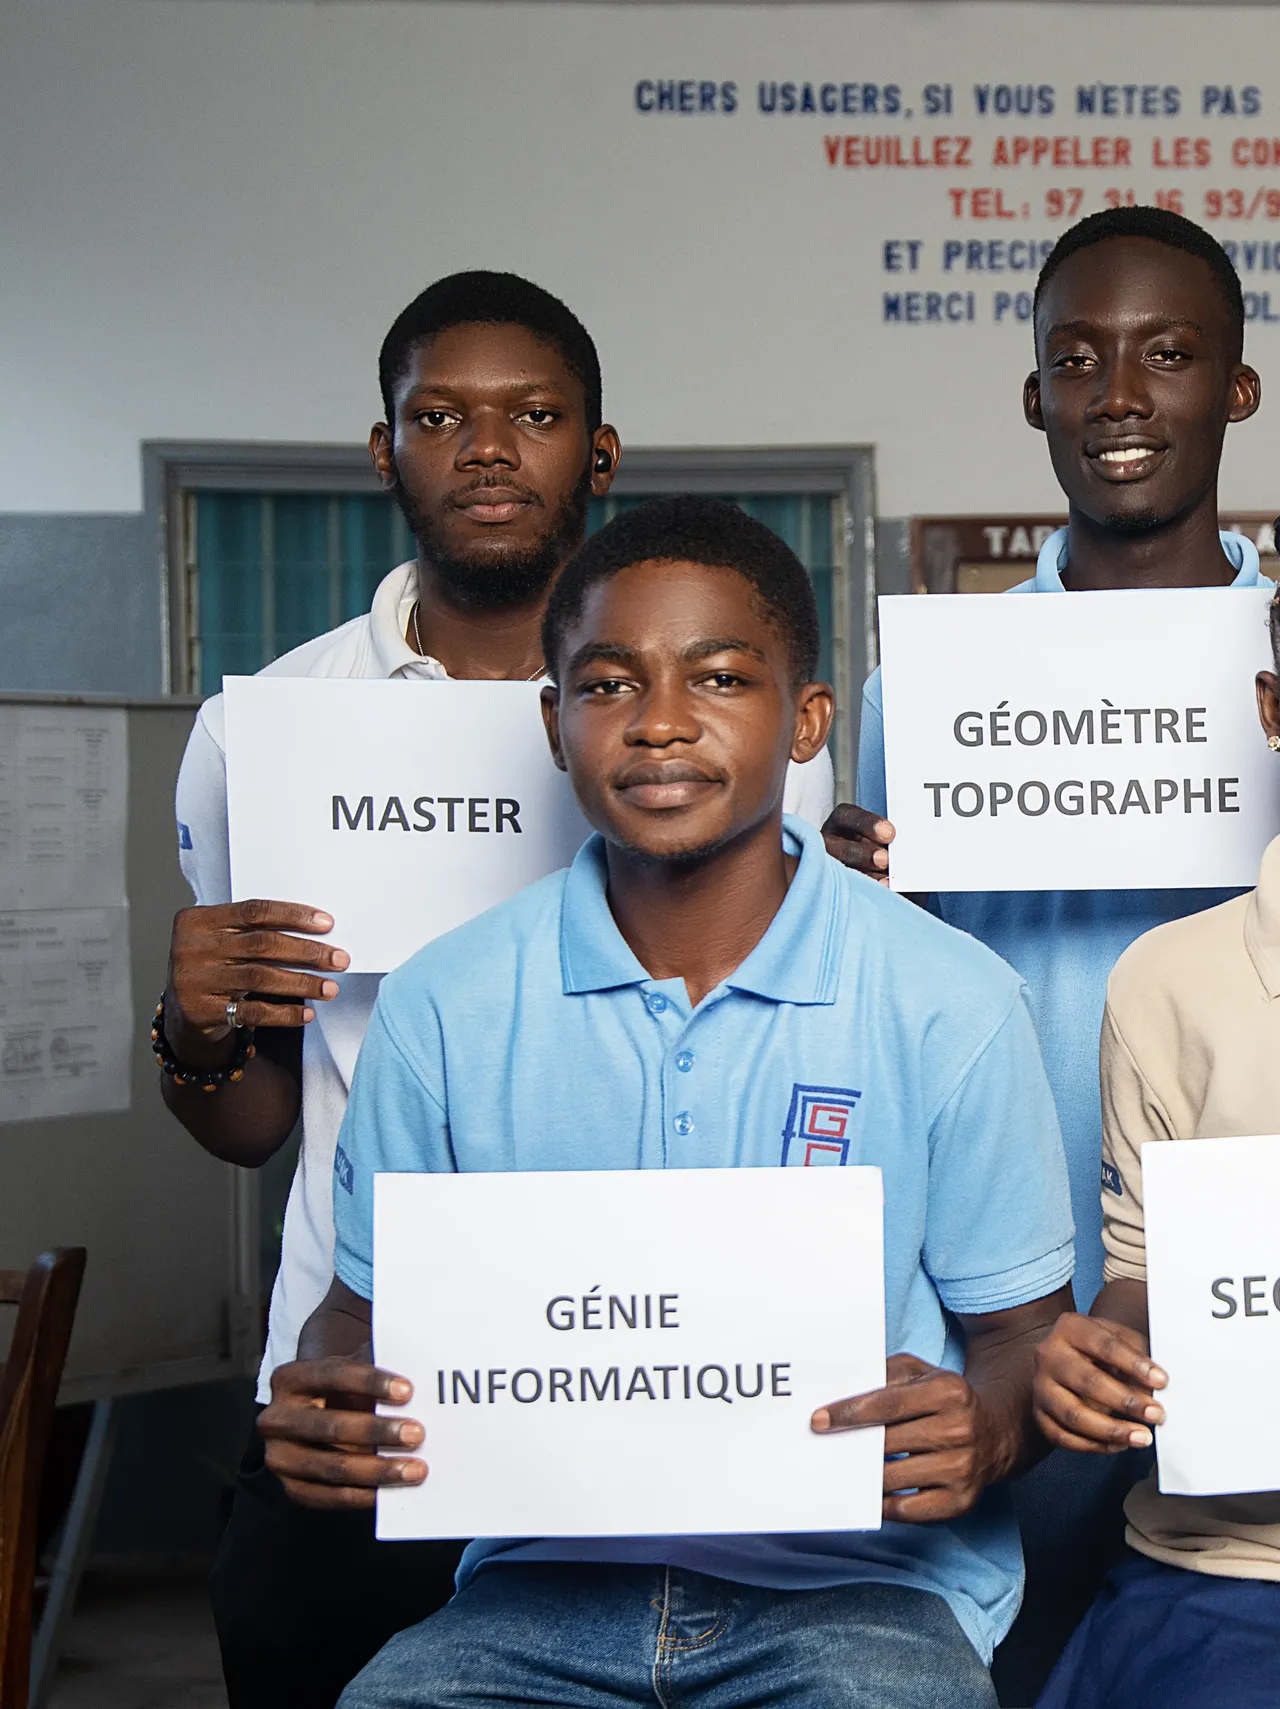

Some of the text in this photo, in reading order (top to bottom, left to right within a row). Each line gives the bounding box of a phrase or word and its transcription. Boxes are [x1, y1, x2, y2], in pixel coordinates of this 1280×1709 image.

[635, 80, 738, 116] CHERS
[924, 84, 954, 116] SI
[976, 85, 1054, 117] VOUS
[1203, 85, 1260, 116] PAS
[823, 135, 973, 168] VEUILLEZ
[992, 136, 1132, 169] APPELER
[1152, 136, 1212, 169] LES
[947, 187, 1031, 221] TEL:
[1044, 187, 1085, 221] 97
[883, 240, 922, 273] ET
[883, 292, 975, 324] MERCI
[953, 698, 1208, 748] GÉOMÈTRE
[332, 795, 523, 834] MASTER
[923, 777, 1240, 818] TOPOGRAPHE
[546, 1285, 680, 1331] GÉNIE
[437, 1363, 792, 1405] INFORMATIQUE
